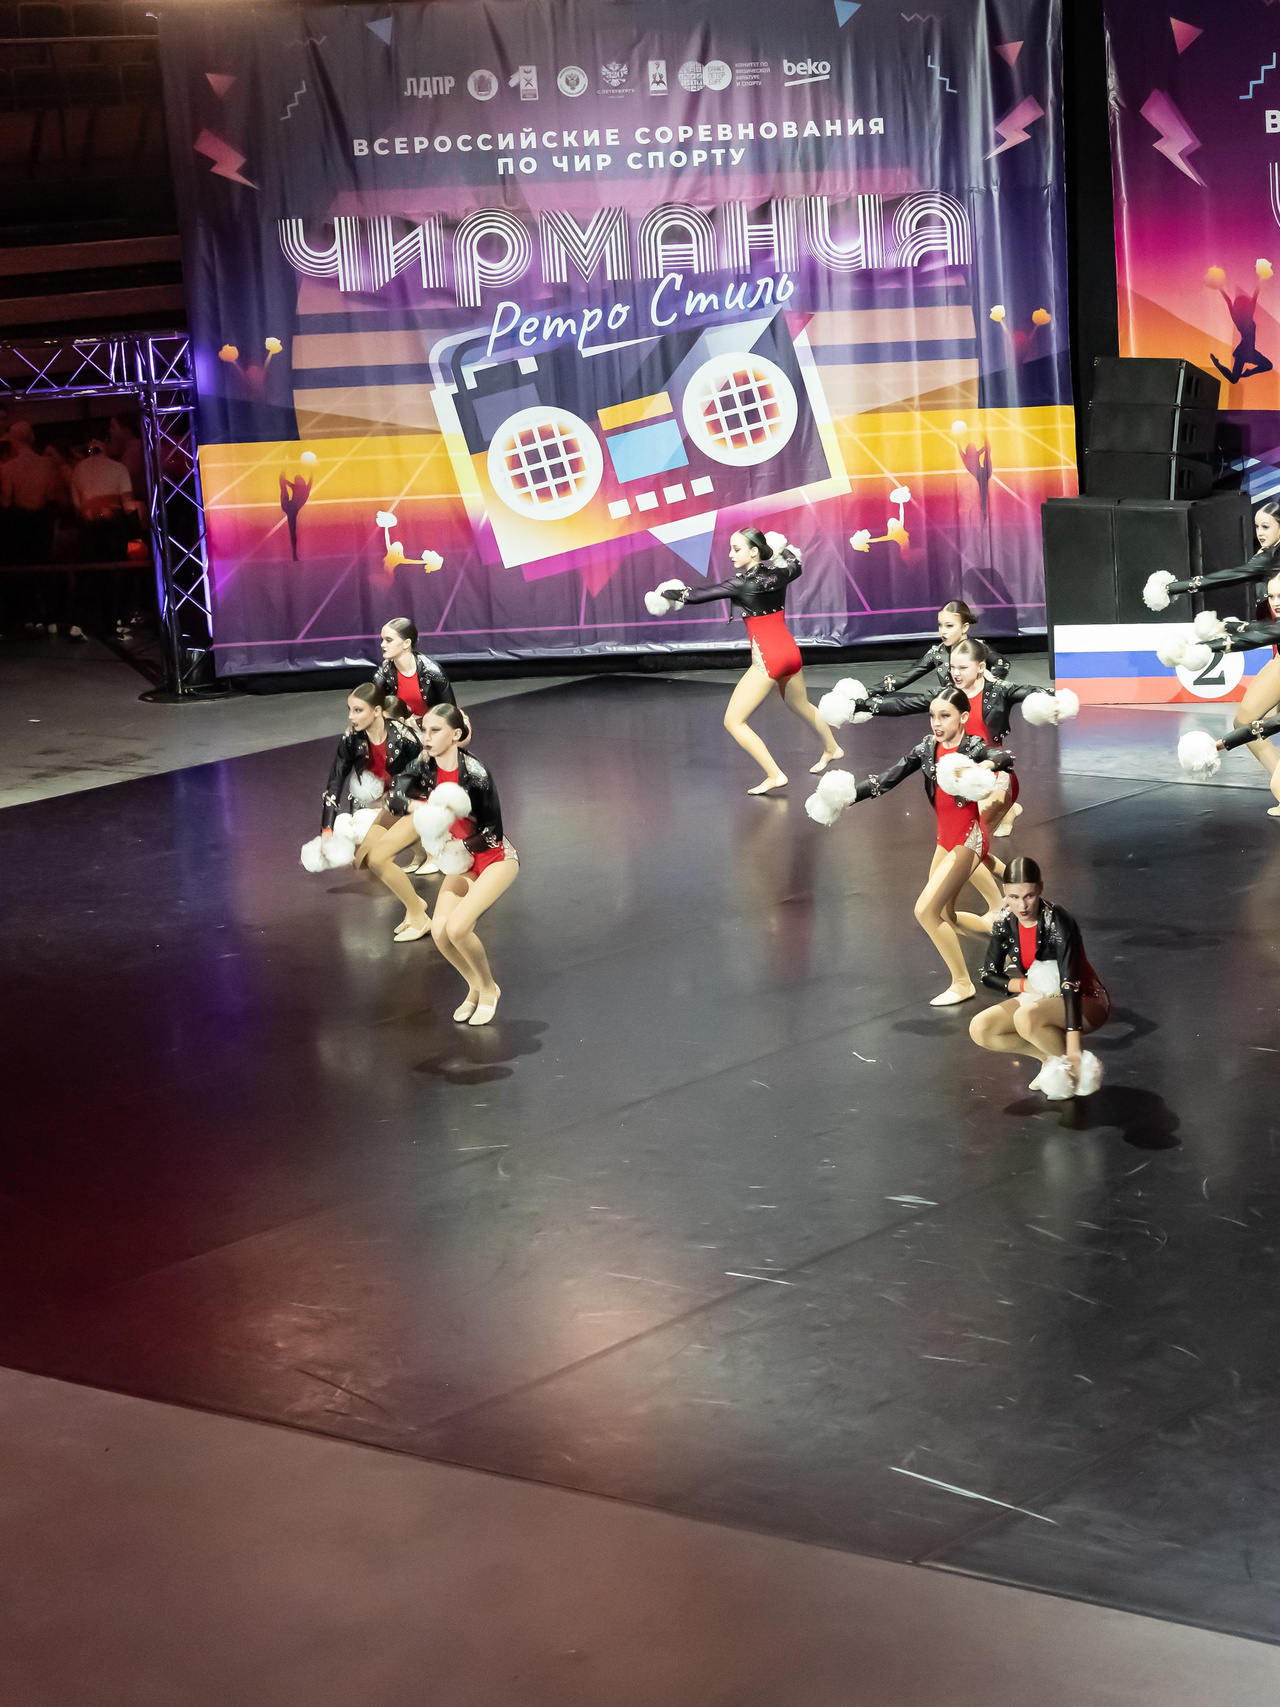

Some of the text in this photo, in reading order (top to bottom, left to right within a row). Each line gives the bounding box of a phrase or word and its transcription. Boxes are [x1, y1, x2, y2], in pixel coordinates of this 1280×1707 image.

[783, 58, 831, 76] beko
[404, 76, 455, 99] ЛДПР
[353, 117, 885, 156] ВСЕРОССИЙСКИЕ СОРЕВНОВАНИЯ
[497, 147, 746, 175] ПО ЧИР СПОРТУ
[487, 272, 795, 357] Ретро Стиль
